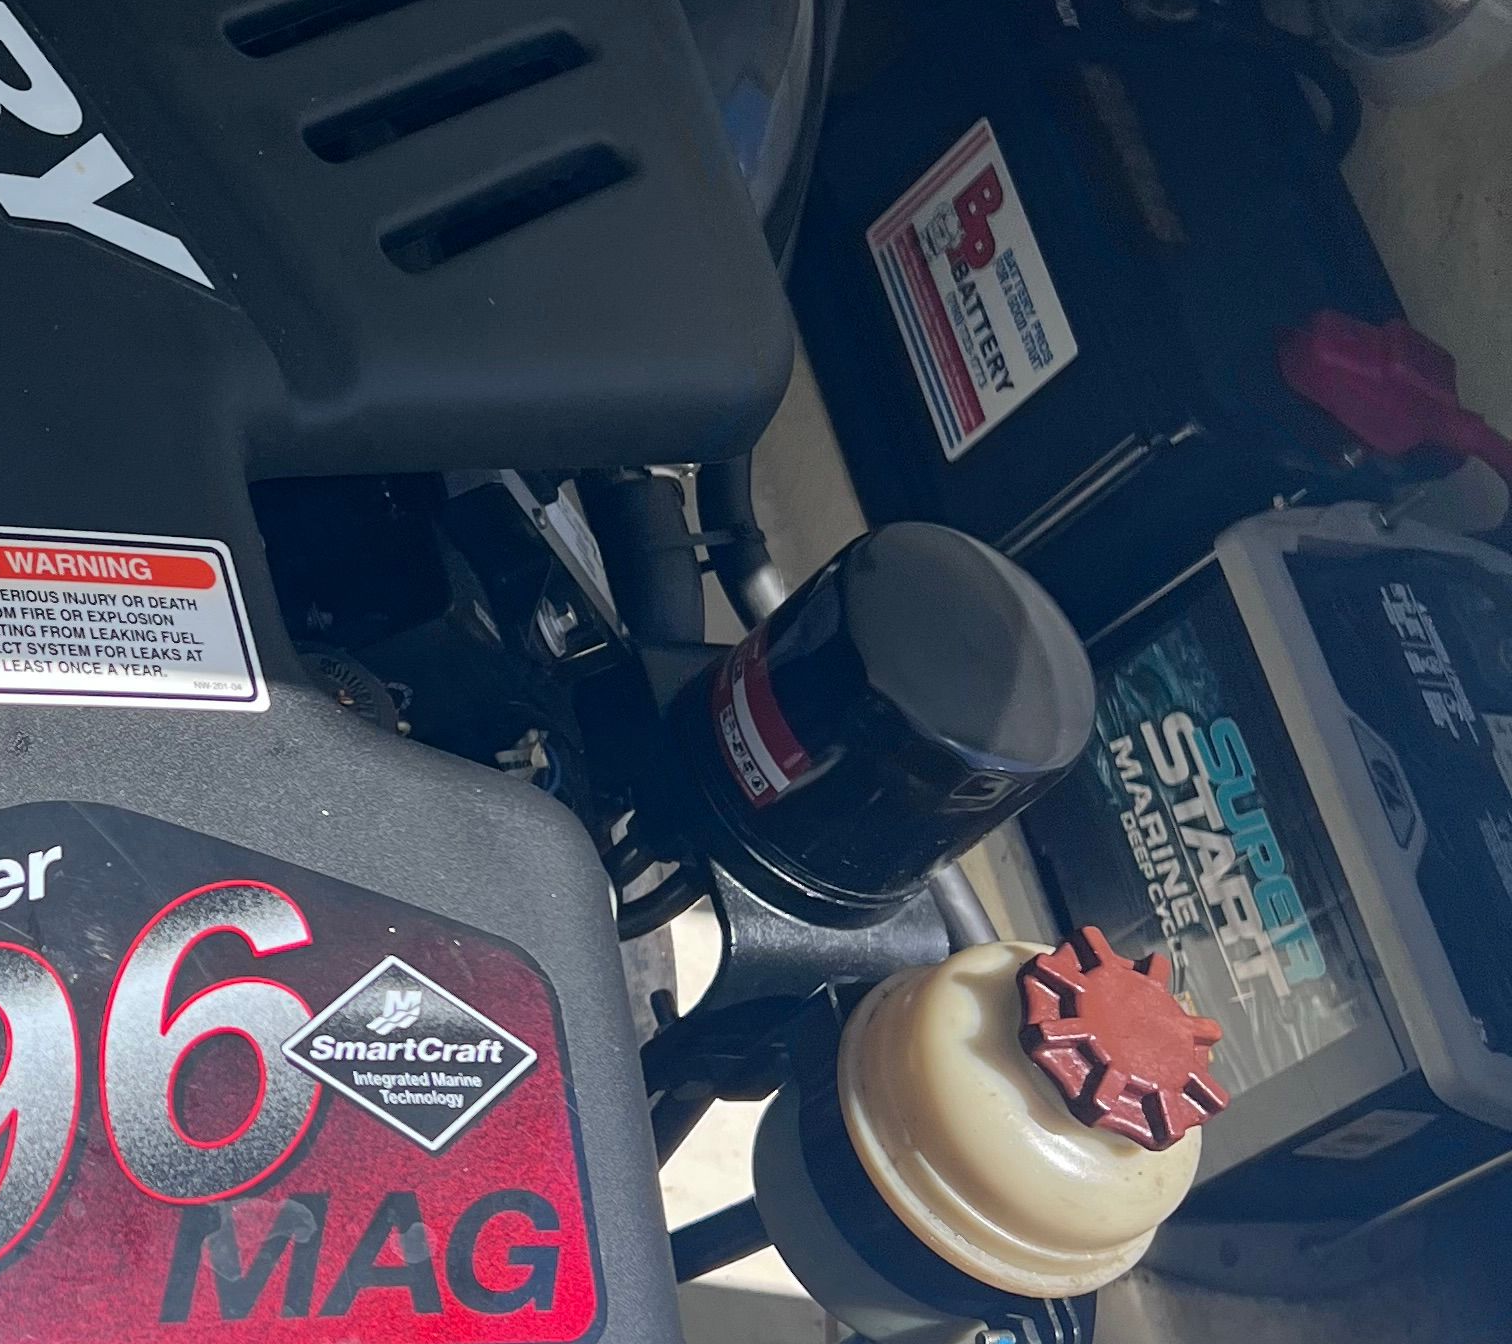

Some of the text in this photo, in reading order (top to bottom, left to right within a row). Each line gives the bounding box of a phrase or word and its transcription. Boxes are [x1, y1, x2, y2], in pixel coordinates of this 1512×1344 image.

[950, 259, 1015, 394] BATTERY
[4, 550, 153, 581] WARNING
[62, 591, 118, 608] INJURY
[122, 594, 144, 609] OR
[148, 596, 197, 612] DEATH
[21, 607, 56, 621] FIRE
[61, 608, 83, 622] OR
[88, 610, 175, 627] EXPLOSION
[40, 625, 86, 640] FROM
[90, 627, 157, 643] LEAKING
[26, 641, 91, 658] SYSTEM
[95, 644, 125, 659] FOR
[131, 646, 180, 661] LEAKS
[182, 648, 204, 662] AT
[1, 659, 168, 678] LEAST ONCE A YEAR.
[1109, 734, 1200, 930] MARINE
[1119, 810, 1154, 883] DEEP
[1140, 711, 1291, 998] START
[1192, 717, 1326, 986] SUPER
[309, 1034, 504, 1064] SmartCraft
[353, 1070, 482, 1089] Integrated Marine
[379, 1089, 464, 1109] Technology
[160, 1189, 562, 1326] MAG
